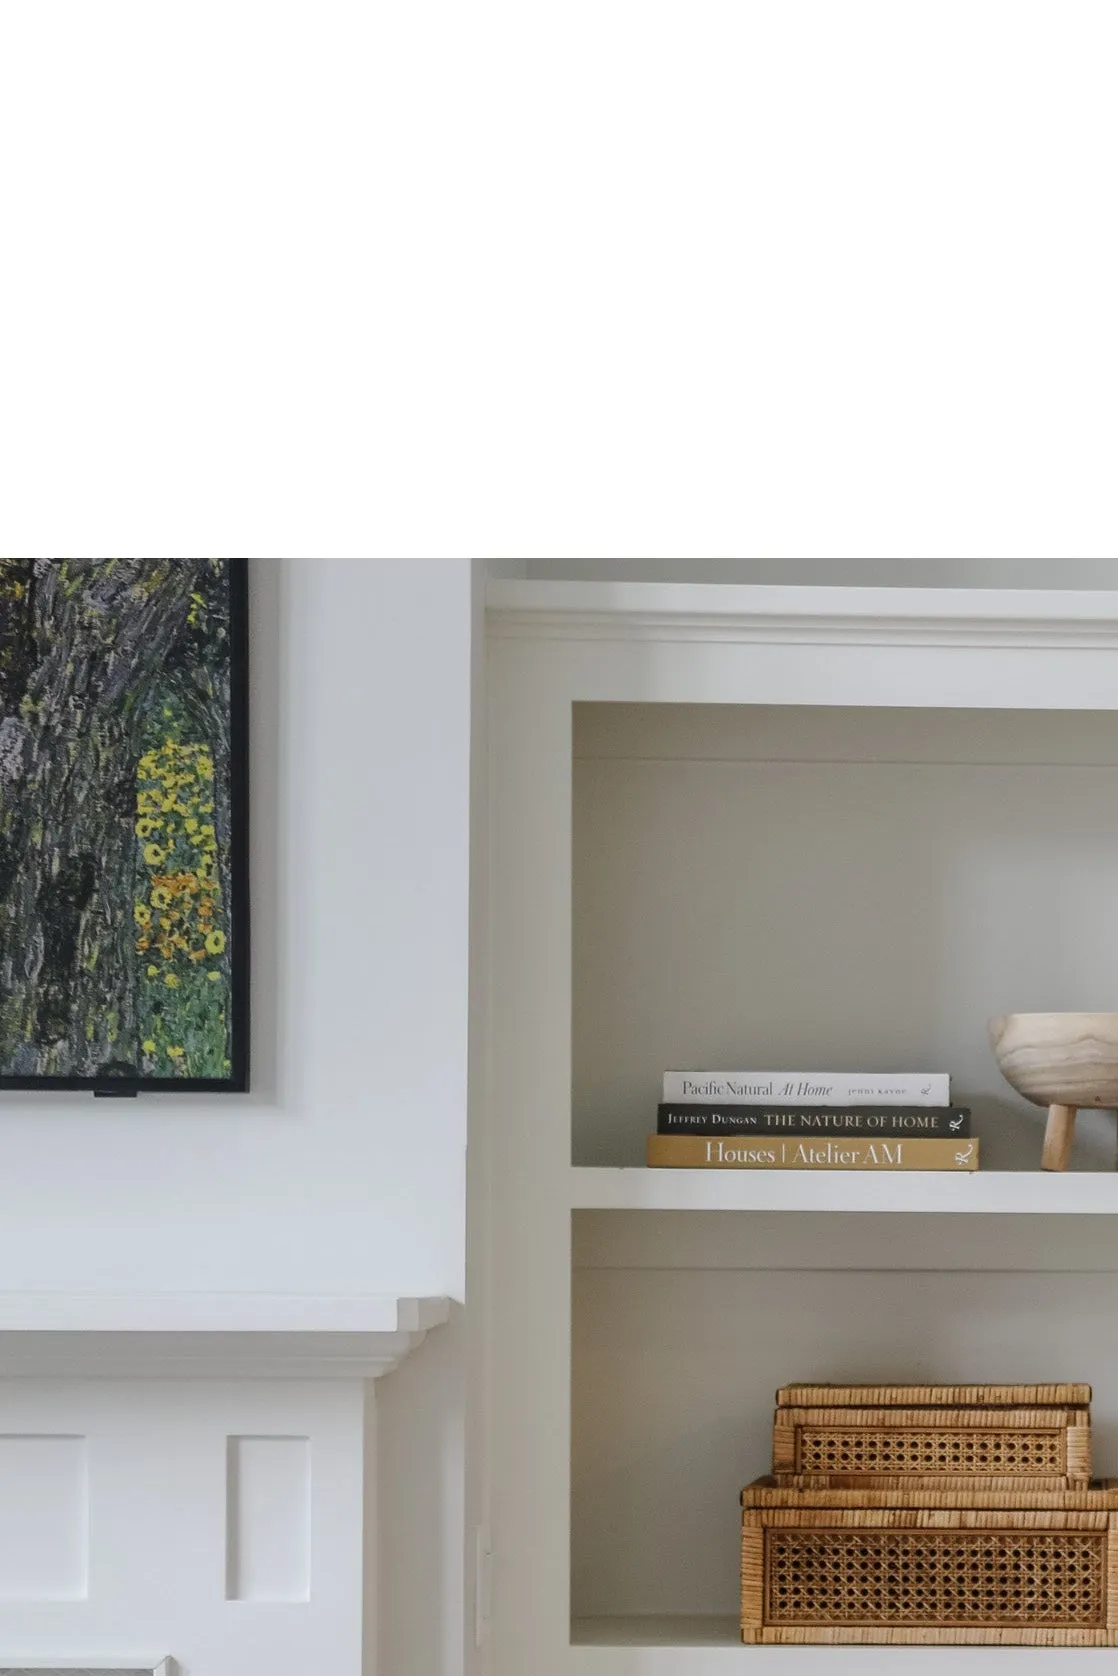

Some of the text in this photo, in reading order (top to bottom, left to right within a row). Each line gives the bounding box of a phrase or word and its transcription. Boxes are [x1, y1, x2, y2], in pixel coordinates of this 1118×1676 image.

[682, 1080, 725, 1096] Pacific
[726, 1081, 773, 1096] Natural
[777, 1082, 795, 1096] At
[797, 1082, 833, 1097] Home
[764, 1114, 796, 1127] THE
[800, 1115, 863, 1128] NATURE
[866, 1115, 888, 1128] OF
[892, 1116, 939, 1129] HOME
[704, 1141, 776, 1164] Houses
[791, 1143, 860, 1165] Atelier
[863, 1144, 904, 1165] AM
